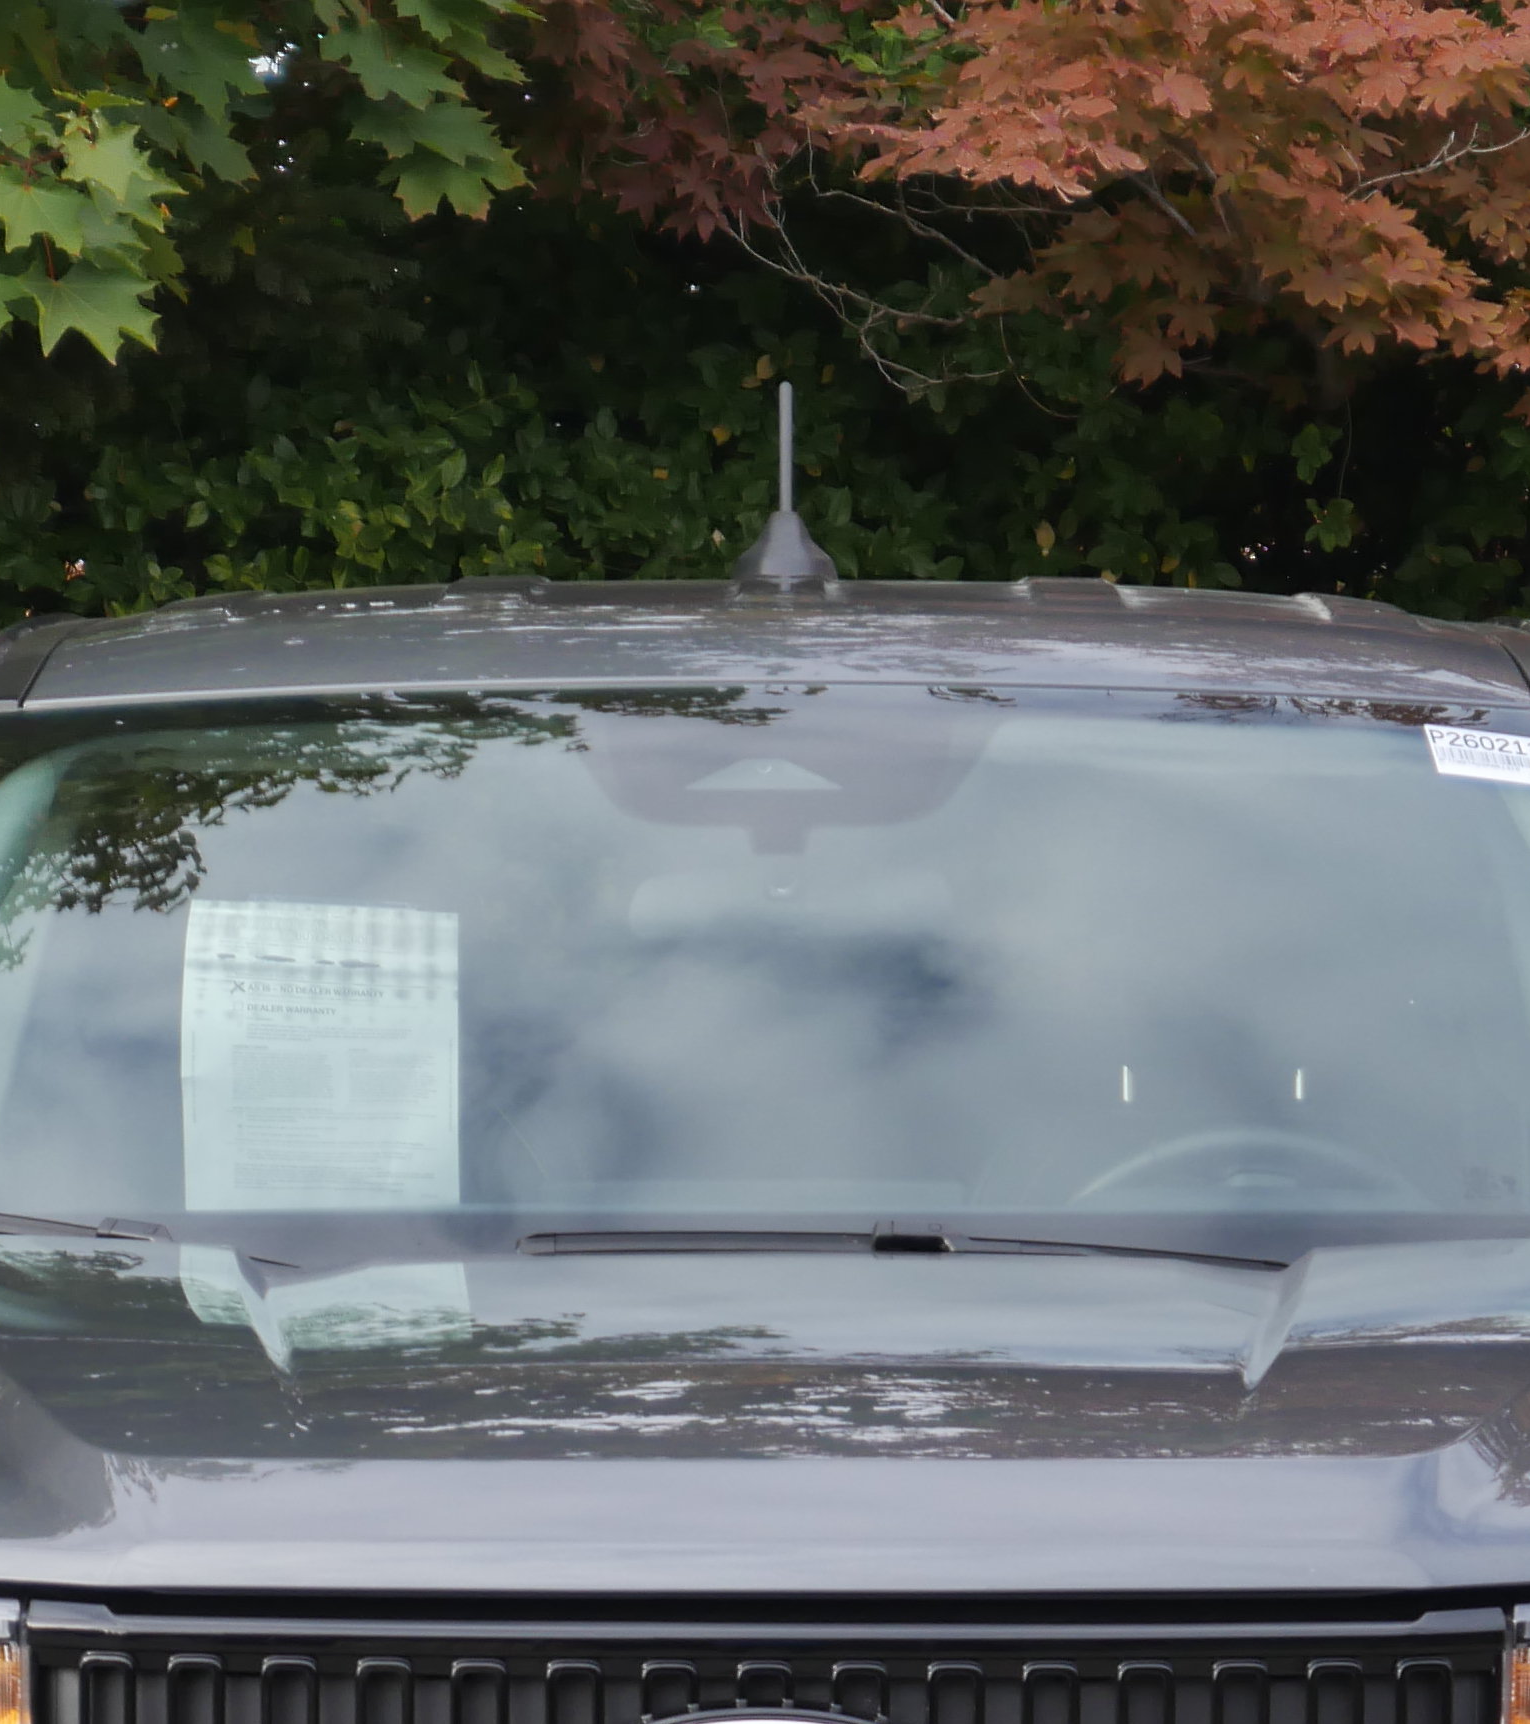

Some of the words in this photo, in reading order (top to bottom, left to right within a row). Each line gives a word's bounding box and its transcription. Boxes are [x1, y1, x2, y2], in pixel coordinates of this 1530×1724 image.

[295, 986, 332, 996] DEALER
[333, 987, 385, 999] WARRANTY
[247, 1003, 284, 1013] DEALER
[285, 1005, 337, 1016] WARRANTY
